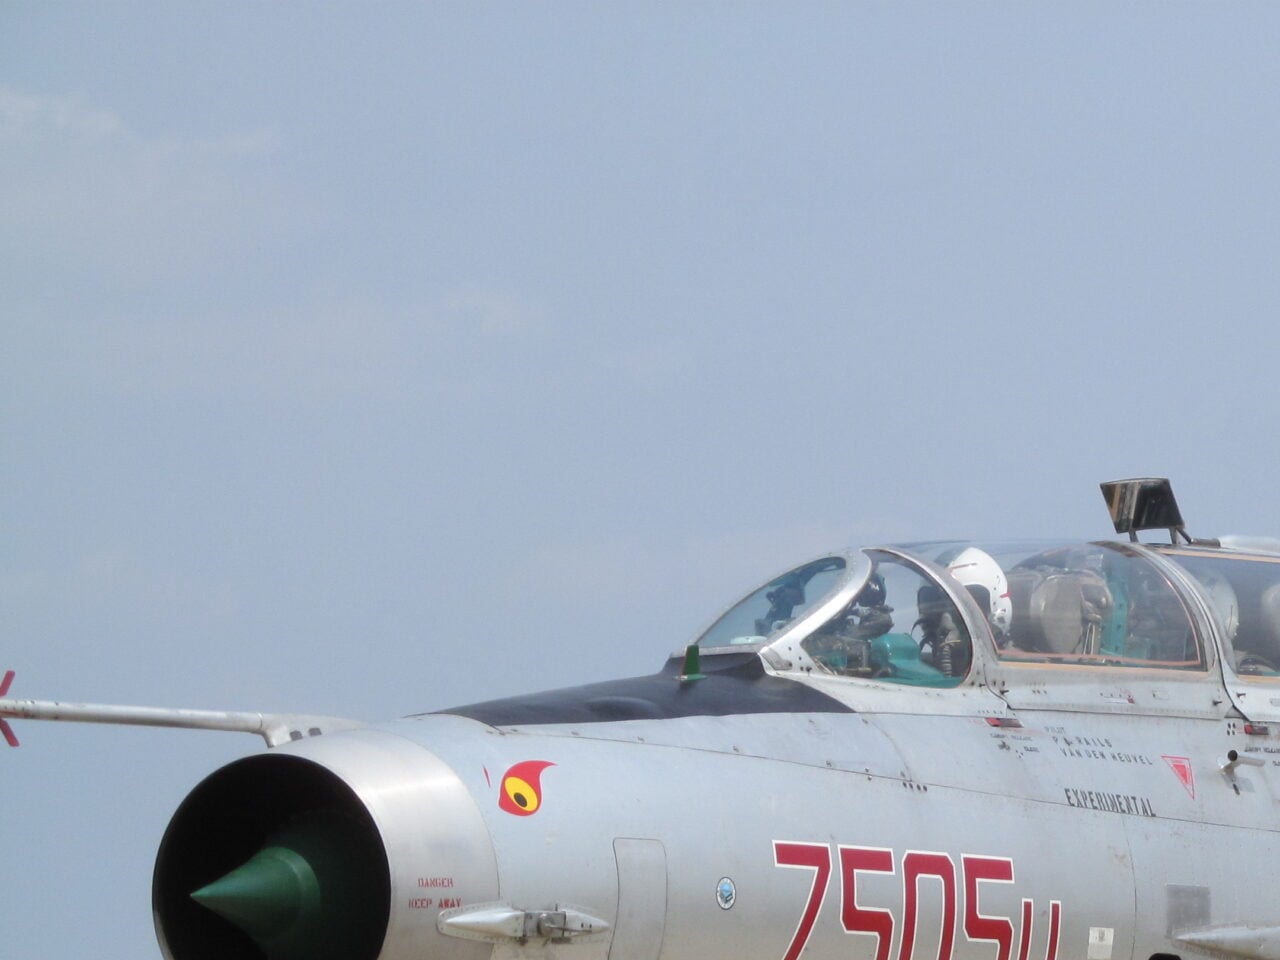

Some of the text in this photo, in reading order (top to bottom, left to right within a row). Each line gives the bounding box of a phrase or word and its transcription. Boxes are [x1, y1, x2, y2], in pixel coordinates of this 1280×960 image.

[1060, 747, 1153, 766] VAN DEN HEUVEL
[1064, 787, 1157, 818] EXPERIMENTAL
[417, 877, 454, 888] DANGER
[408, 897, 462, 909] KEEP AWAY
